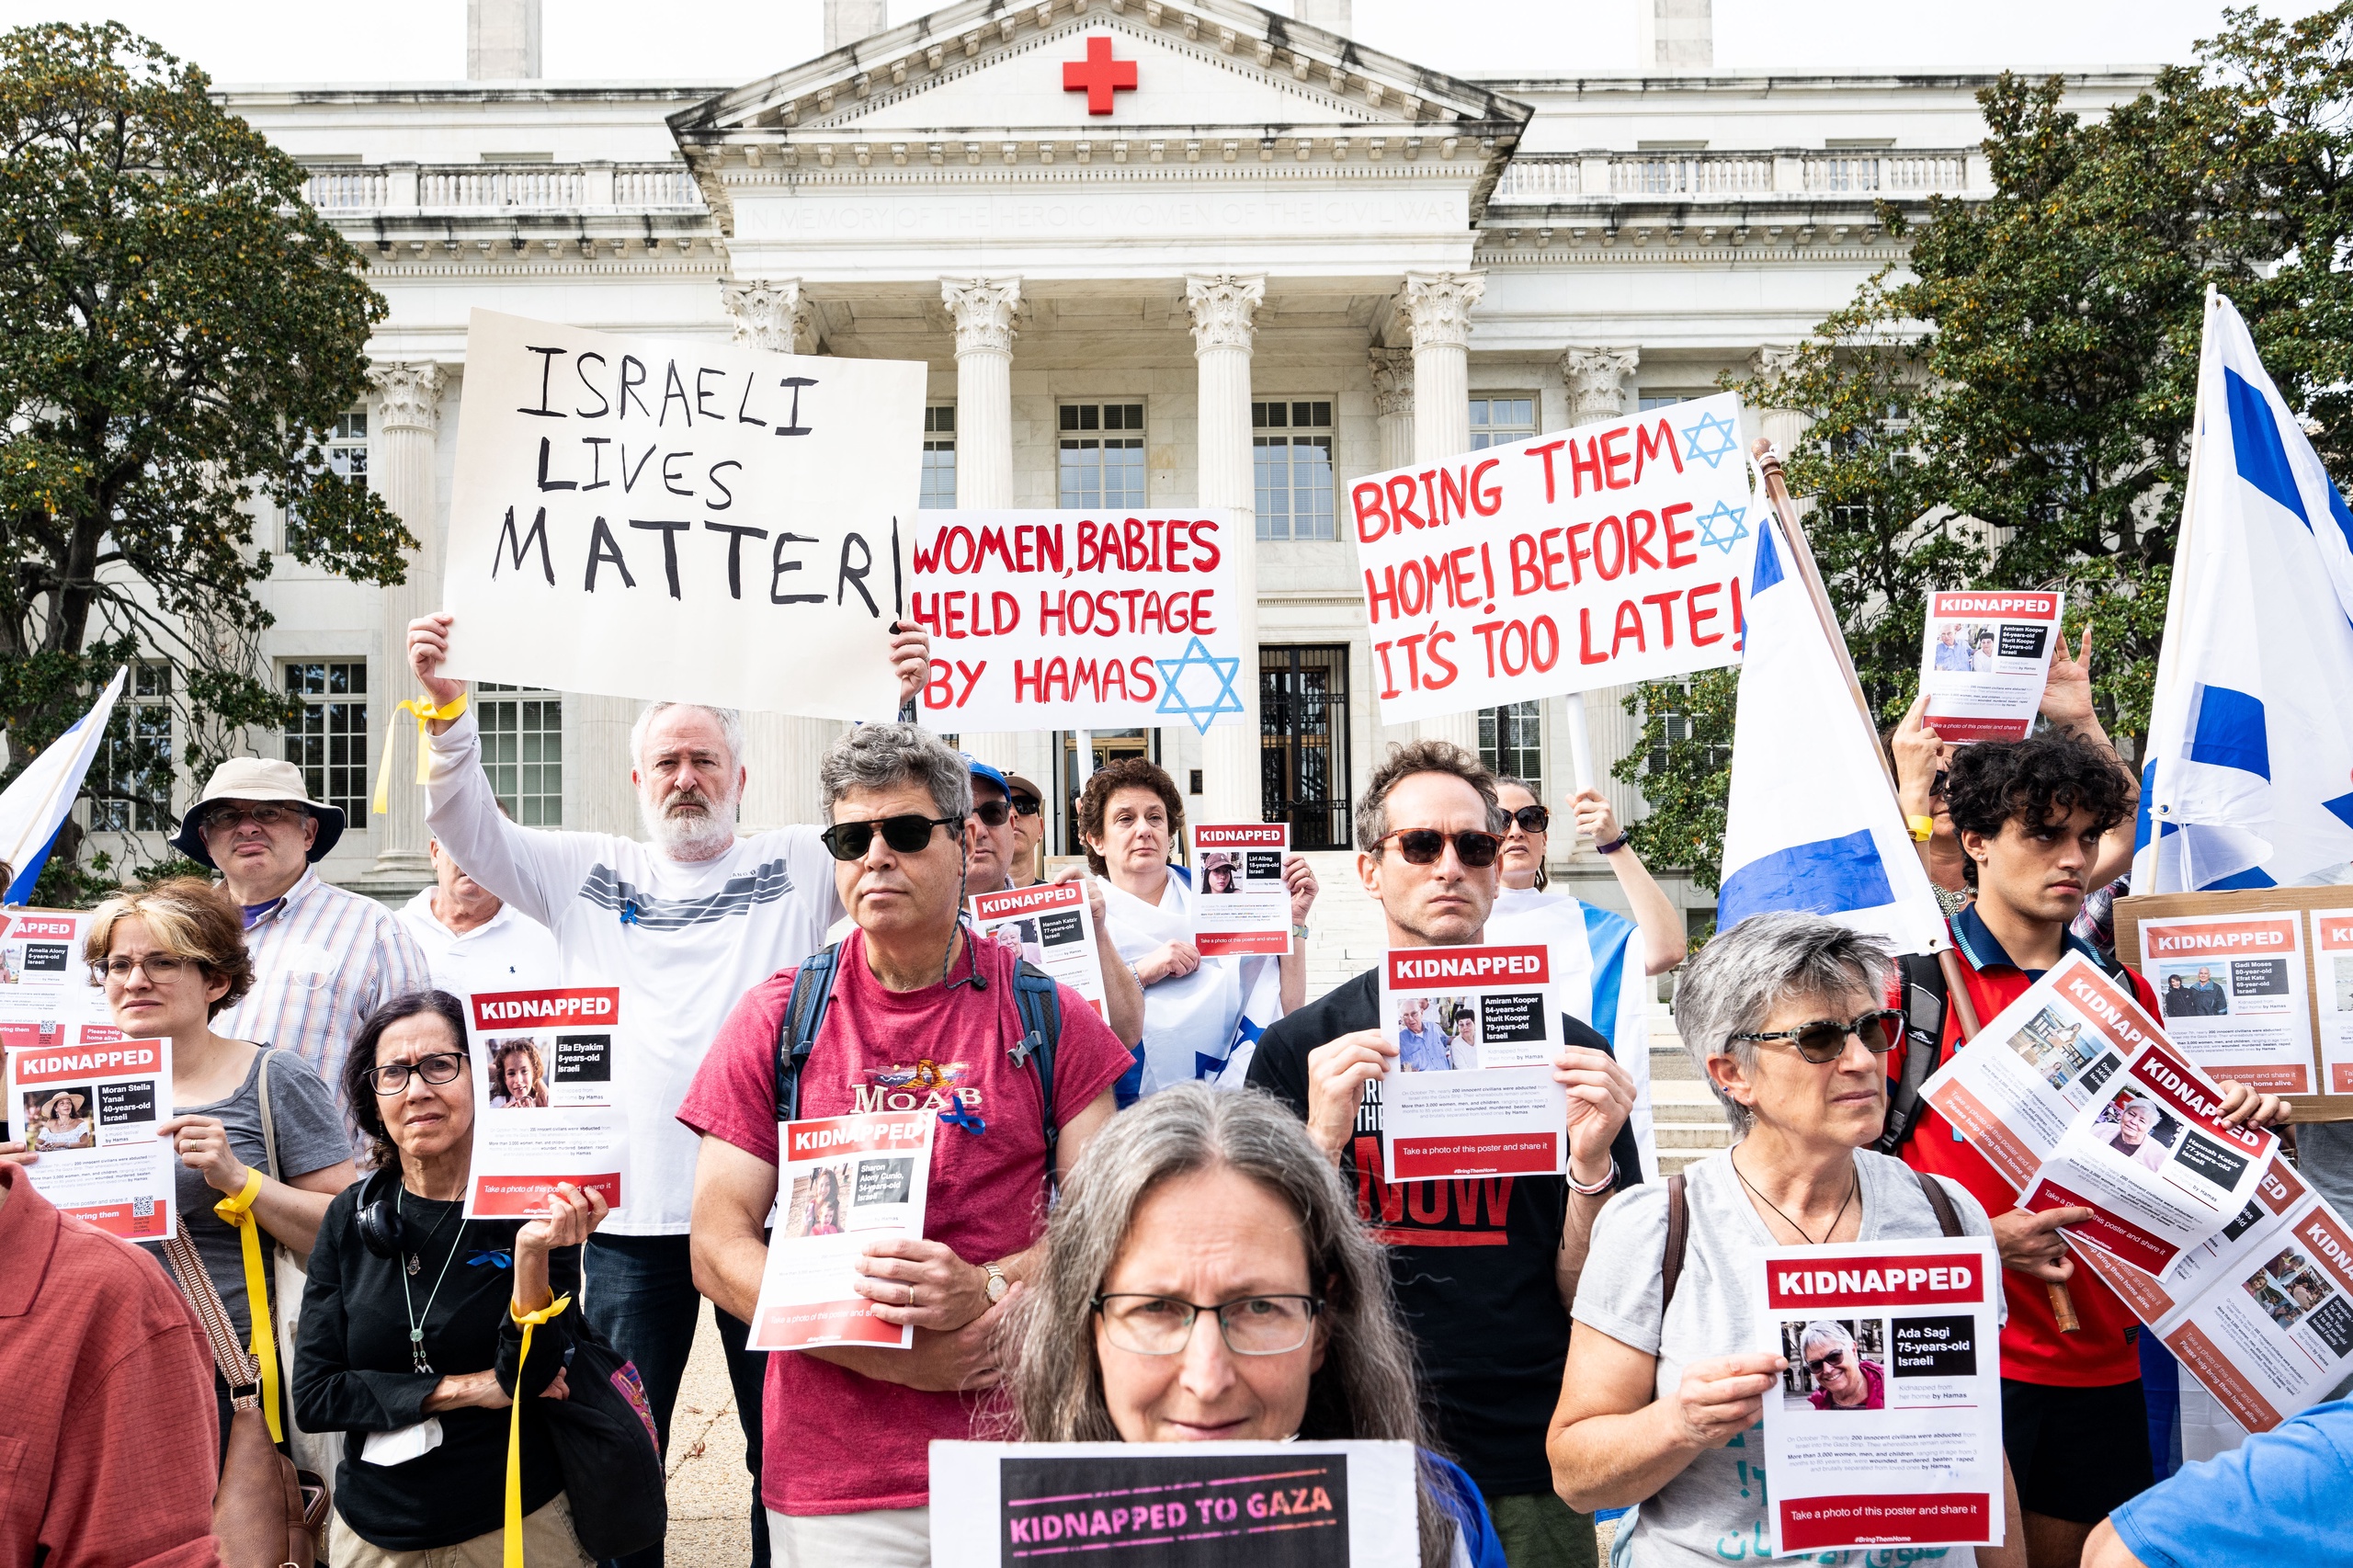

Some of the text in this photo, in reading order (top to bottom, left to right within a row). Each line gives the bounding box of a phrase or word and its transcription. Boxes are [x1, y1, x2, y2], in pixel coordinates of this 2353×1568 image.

[779, 207, 889, 229] MEMORY
[896, 206, 932, 229] OF
[939, 206, 989, 228] THE
[999, 205, 1097, 227] HEROIC
[1106, 203, 1211, 226] WOMEN
[1222, 202, 1256, 224] OF
[1266, 201, 1314, 224] THE
[1324, 201, 1393, 223] CIVIL
[1398, 200, 1459, 222] WAR
[517, 346, 819, 436] ISRAELI
[537, 436, 743, 510] LIVES
[1352, 418, 1684, 543] BRING THEM
[913, 517, 1222, 579] WOMEN, BABIES
[1365, 502, 1699, 624] HOME! BEFORE
[492, 506, 904, 635] MATTER!
[1940, 598, 2051, 613] KIDNAPPED
[912, 588, 1218, 639] HELD HOSTAGE
[1374, 576, 1744, 699] IT'S TOO LATE!
[924, 655, 1158, 710] BY HAMAS
[1199, 830, 1281, 842] KIDNAPPED
[982, 888, 1077, 914] KIDNAPPED
[16, 922, 71, 935] APPED
[2157, 930, 2284, 950] KIDNAPPED
[1396, 955, 1541, 979] KIDNAPPED
[2234, 968, 2273, 976] 80-year-old
[1512, 996, 1540, 1005] Kooper
[480, 996, 611, 1020] KIDNAPPED
[1484, 1005, 1529, 1015] 84-years-old
[2068, 977, 2144, 1051] KIDNAP
[1504, 1014, 1530, 1022] Kooper
[87, 1028, 120, 1037] Please help
[1485, 1022, 1529, 1032] 79-years-old
[1486, 1032, 1508, 1040] Israeli
[558, 1042, 604, 1053] Ella Elyakim
[23, 1049, 153, 1075] KIDNAPPED
[558, 1053, 600, 1064] 8-years-old
[557, 1064, 580, 1073] Israeli
[2212, 1070, 2296, 1081] of this poster and share it
[102, 1083, 151, 1095] Moran Stella
[2253, 1079, 2294, 1087] home alive.
[102, 1095, 124, 1103] Yanai
[849, 1084, 983, 1115] MOAB
[102, 1102, 152, 1113] 40-years-old
[103, 1113, 128, 1122] Israeli
[795, 1122, 919, 1151] KIDNAPPED
[1403, 1147, 1421, 1155] Take
[1428, 1146, 1451, 1156] photo
[1452, 1145, 1461, 1153] of
[1477, 1145, 1501, 1154] poster
[1503, 1143, 1518, 1152] and
[1519, 1142, 1541, 1151] share
[1542, 1142, 1548, 1150] it
[2188, 1138, 2242, 1168] Hannah Katzir
[2181, 1150, 2206, 1166] Israeli
[2185, 1143, 2232, 1172] 77-years-old
[860, 1164, 886, 1173] Sharon
[483, 1185, 499, 1194] Take
[506, 1185, 525, 1196] photo
[526, 1184, 533, 1193] of
[534, 1184, 546, 1193] this
[857, 1193, 878, 1202] Israeli
[76, 1210, 119, 1221] bring them
[1778, 1266, 1972, 1296] KIDNAPPED
[1896, 1326, 1950, 1340] Ada Sagi
[1896, 1340, 1971, 1354] 75-years-old
[1897, 1355, 1934, 1367] Israeli
[1898, 1383, 1937, 1392] Kidnapped
[1932, 1392, 1941, 1401] by
[1009, 1485, 1334, 1545] KIDNAPPED TO GAZA
[1790, 1510, 1813, 1521] Take
[1822, 1507, 1851, 1520] photo
[1852, 1506, 1862, 1516] of
[1864, 1506, 1882, 1516] this
[1884, 1506, 1916, 1517] poster
[1918, 1505, 1938, 1515] and
[1940, 1505, 1969, 1514] share
[1970, 1504, 1977, 1514] it
[1854, 1535, 1912, 1544] #BringThemHome
